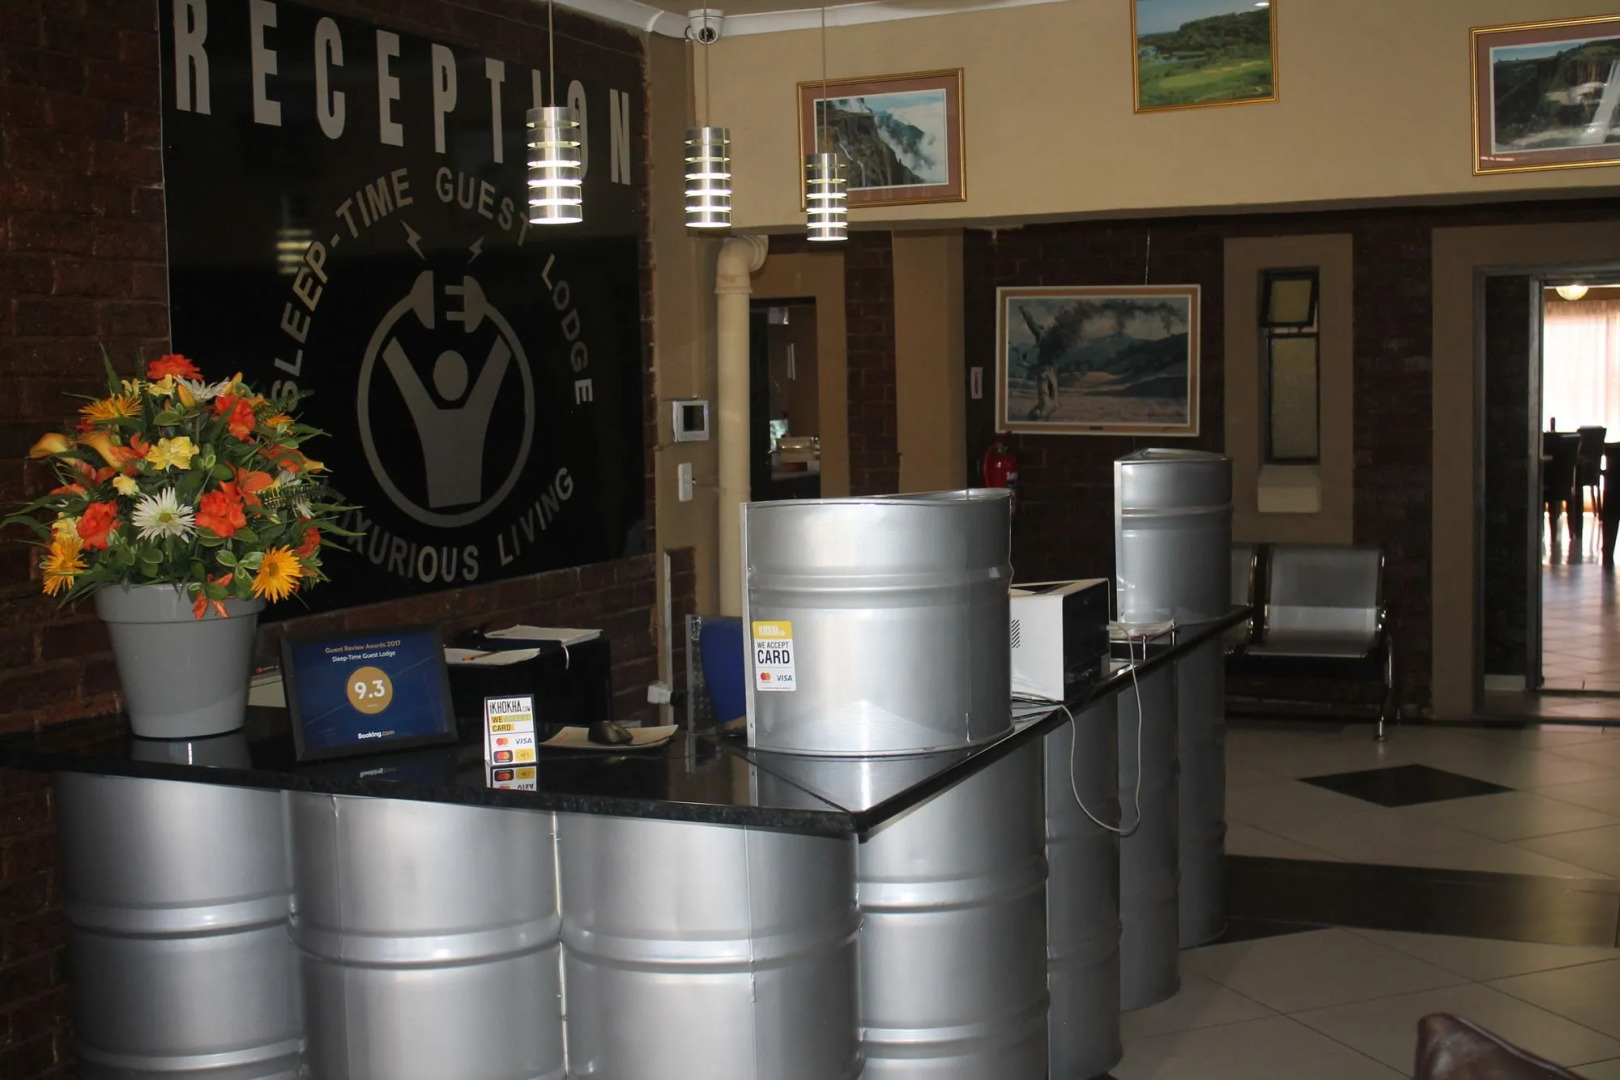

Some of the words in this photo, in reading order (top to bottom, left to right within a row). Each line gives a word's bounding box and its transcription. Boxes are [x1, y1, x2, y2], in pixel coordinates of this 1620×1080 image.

[435, 166, 534, 247] GUEST
[541, 253, 594, 405] LODGE
[498, 466, 575, 567] LIVING
[325, 646, 343, 654] Guest
[344, 644, 364, 652] Review
[365, 641, 386, 650] Awards
[387, 639, 401, 647] 2017
[757, 641, 765, 649] WE
[766, 641, 789, 649] ACCEPT
[332, 653, 362, 663] Sleep-Time
[362, 652, 378, 660] Guest
[379, 650, 396, 659] Lodge
[757, 649, 790, 664] CARD
[776, 674, 793, 682] VISA
[354, 680, 386, 699] 9.3
[491, 715, 503, 723] WE
[492, 723, 512, 732] CARD
[357, 730, 395, 740] Booking.com
[515, 737, 532, 745] VISA
